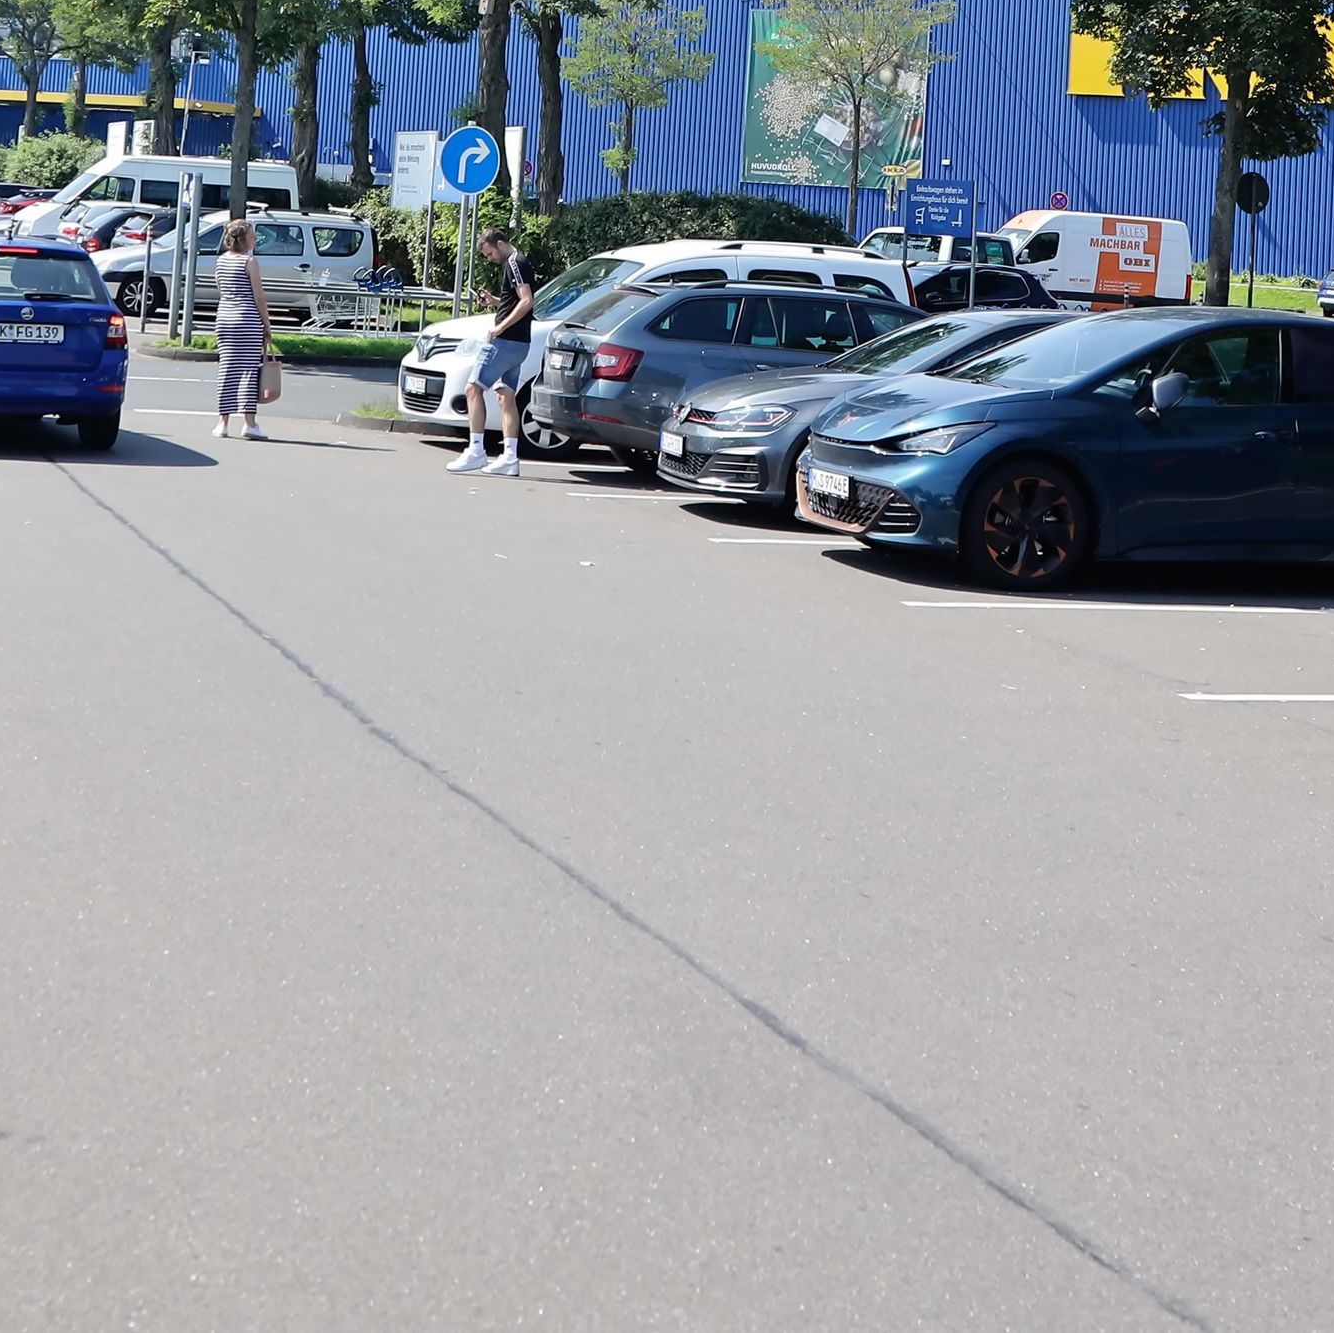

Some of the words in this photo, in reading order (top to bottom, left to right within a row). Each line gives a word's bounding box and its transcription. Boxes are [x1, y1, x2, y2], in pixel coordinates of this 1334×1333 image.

[1119, 226, 1146, 238] ALLES
[1089, 238, 1140, 251] MACHBAR
[1123, 257, 1151, 267] OBI
[0, 325, 7, 337] K
[17, 326, 33, 338] FG
